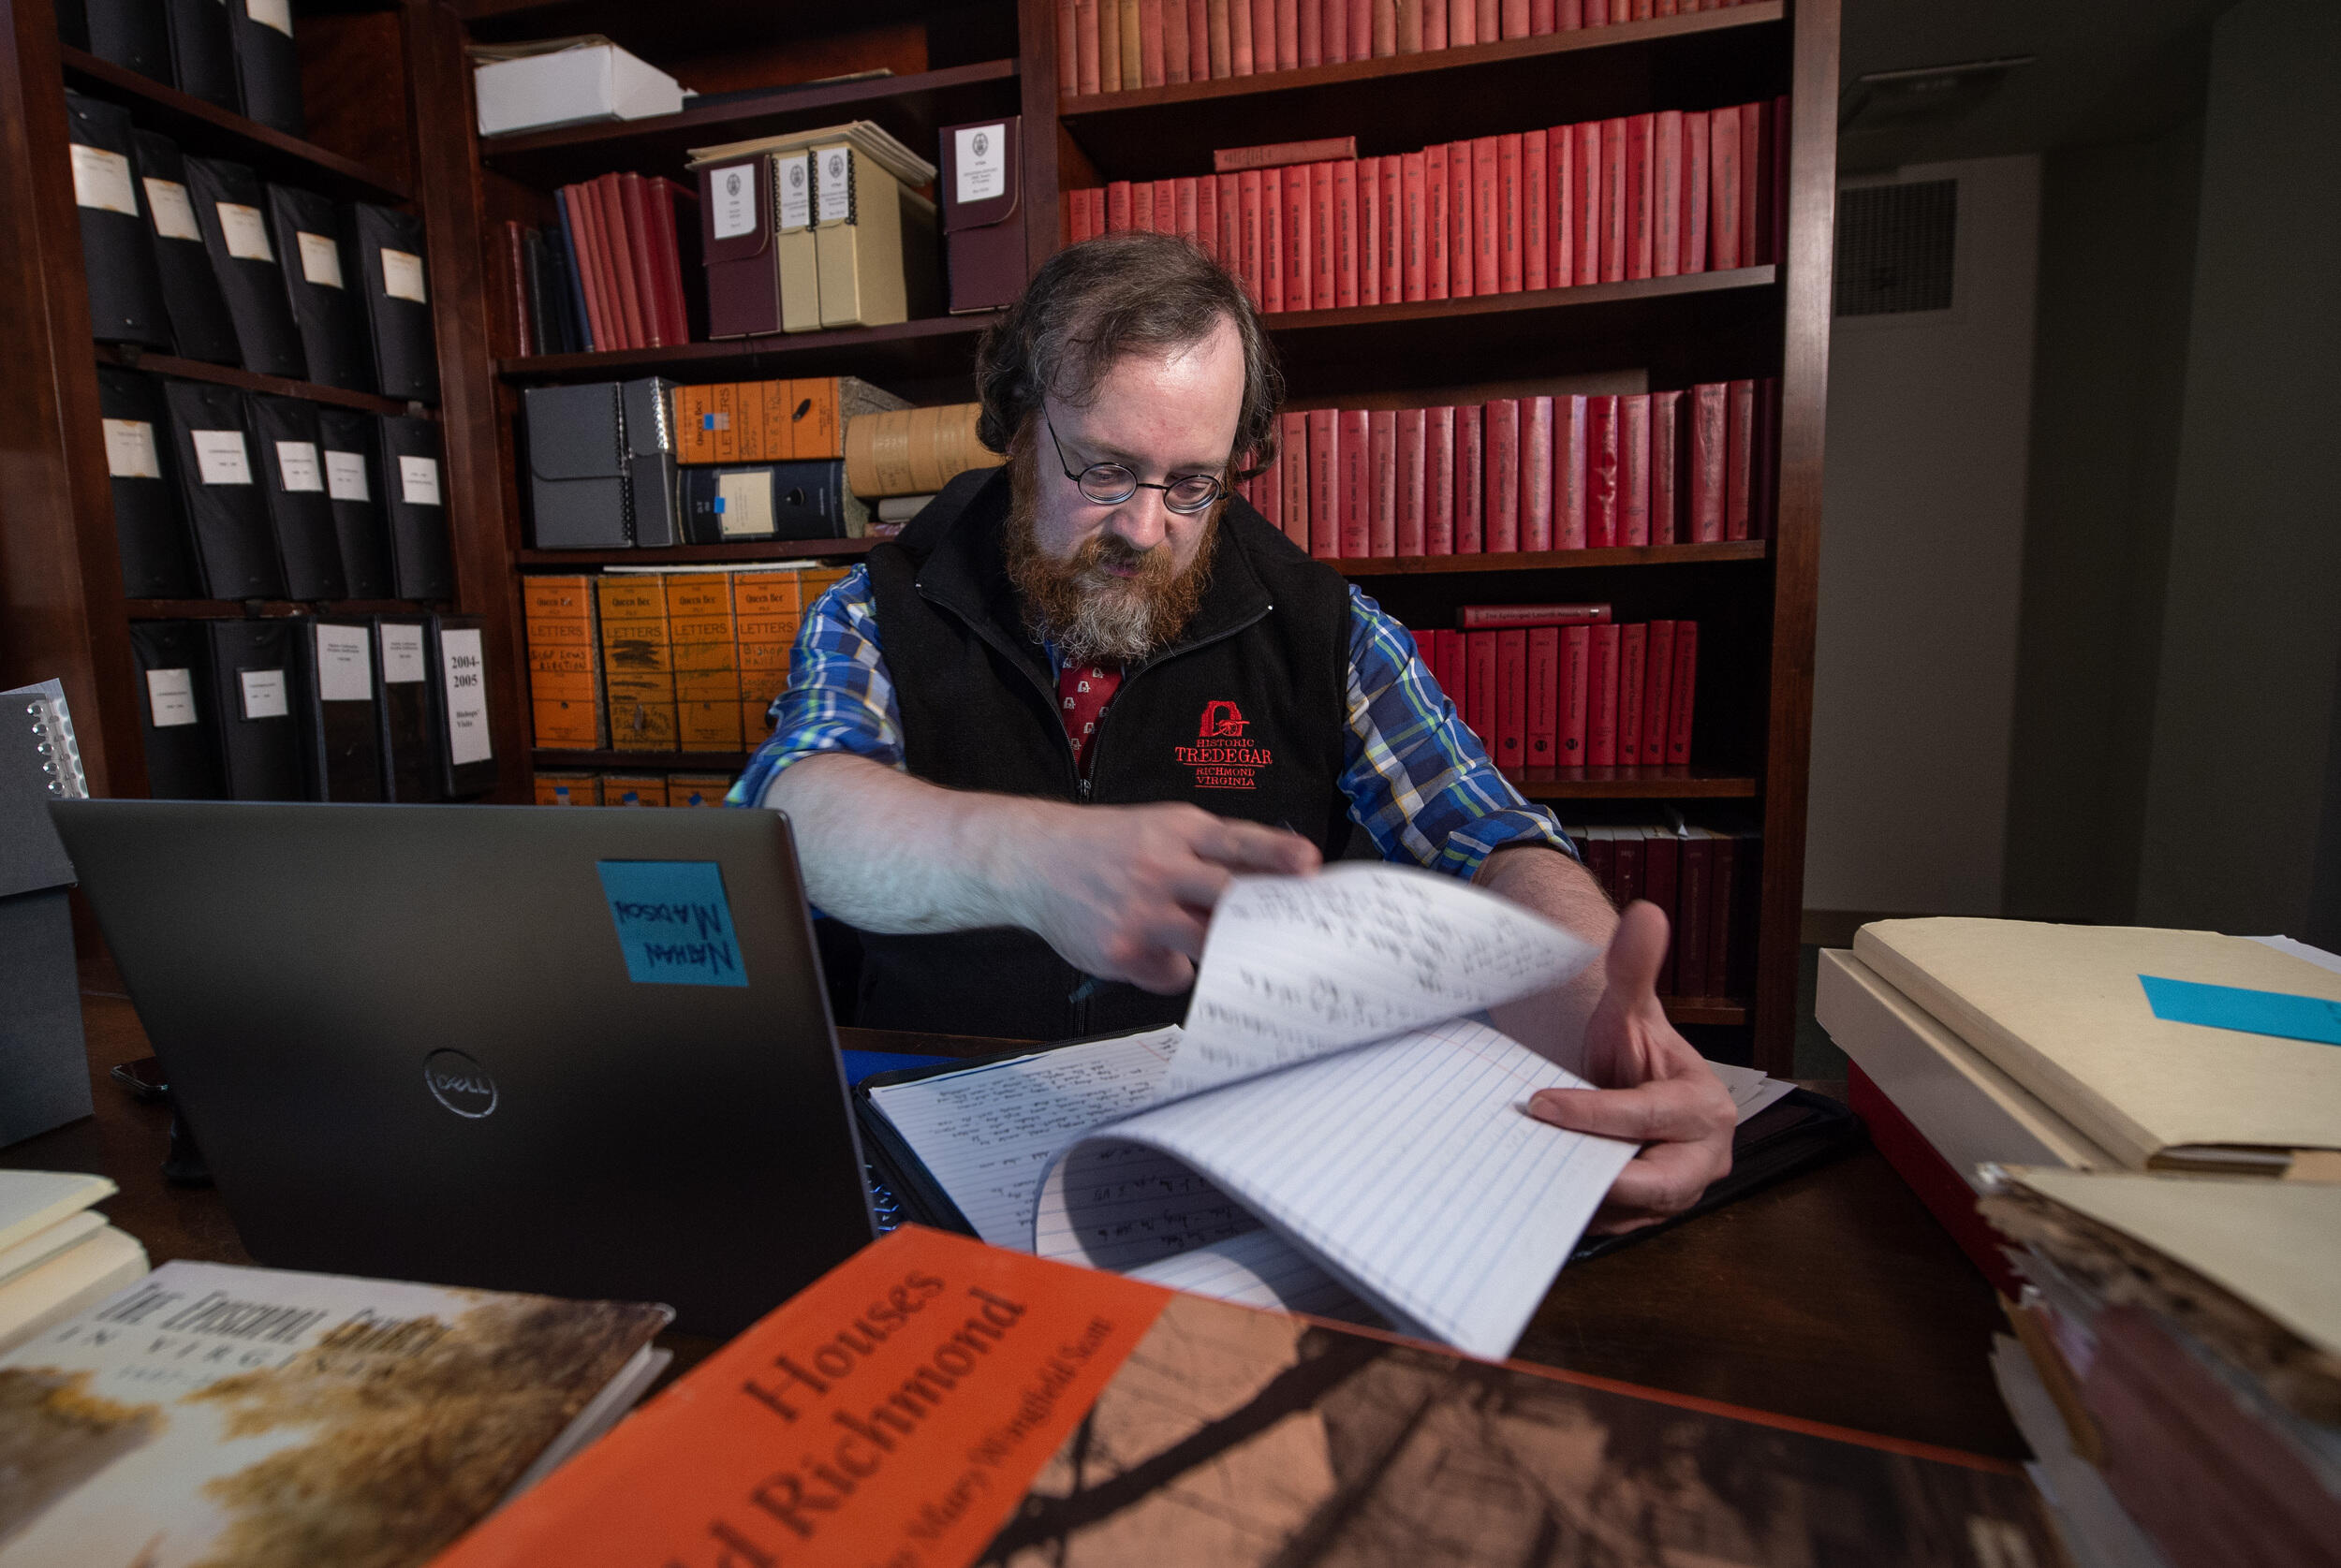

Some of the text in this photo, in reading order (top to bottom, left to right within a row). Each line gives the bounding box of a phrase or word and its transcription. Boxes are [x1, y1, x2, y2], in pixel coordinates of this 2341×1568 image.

[530, 625, 583, 637] LETTERS
[606, 626, 662, 639] LETTERS
[673, 623, 728, 637] LETTERS
[740, 622, 795, 635] LETTERS
[451, 656, 479, 669] 2004-
[453, 674, 478, 688] 2005
[1196, 739, 1255, 747] HISTORIC
[1174, 746, 1273, 765] TREDEGAR
[1196, 767, 1256, 777] RICHMOND
[1197, 776, 1255, 786] VIRGINIA
[643, 940, 735, 975] NATHAN
[434, 1074, 492, 1095] DELL
[743, 1269, 945, 1422] Houses
[749, 1285, 1027, 1542] Richmond
